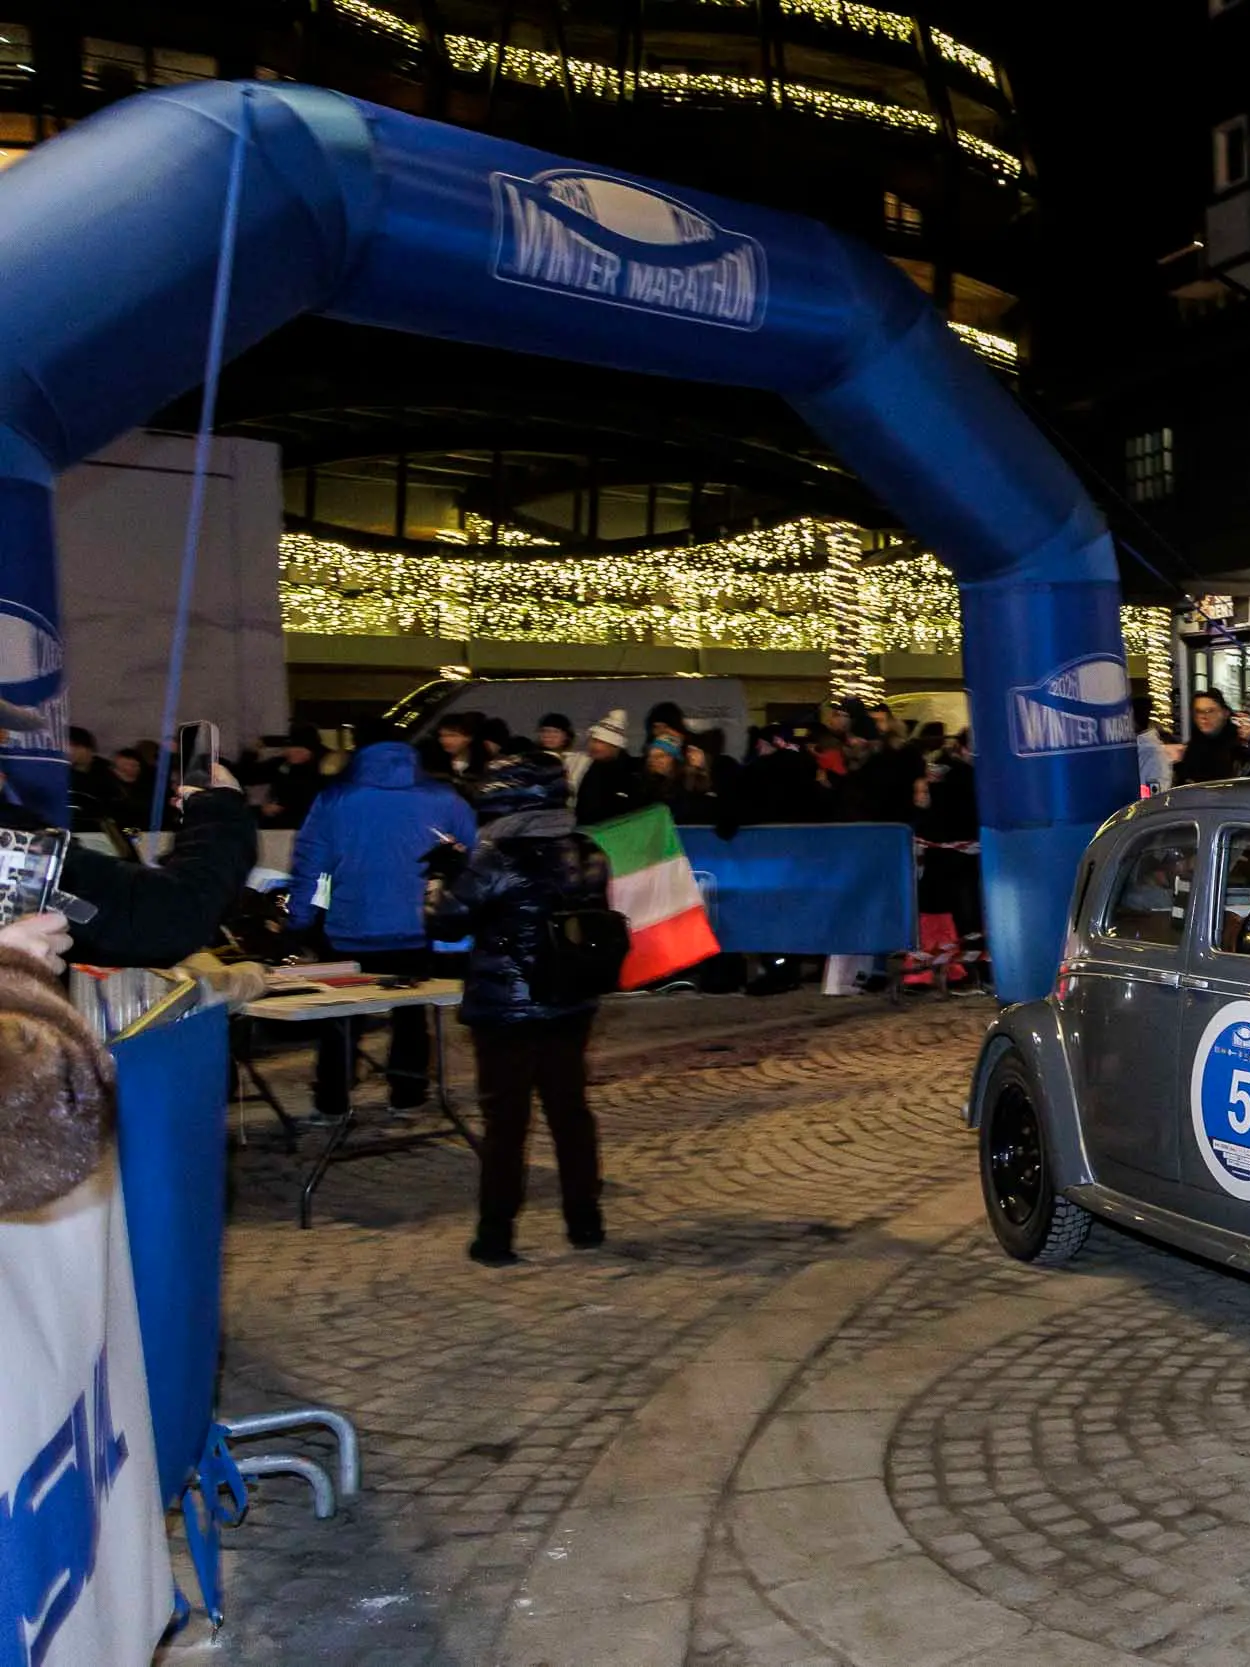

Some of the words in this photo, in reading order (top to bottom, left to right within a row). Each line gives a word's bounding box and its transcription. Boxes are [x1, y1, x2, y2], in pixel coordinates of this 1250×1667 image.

[502, 182, 621, 296] WINTER
[627, 243, 757, 323] MARATHON
[1015, 694, 1100, 751] WINTER
